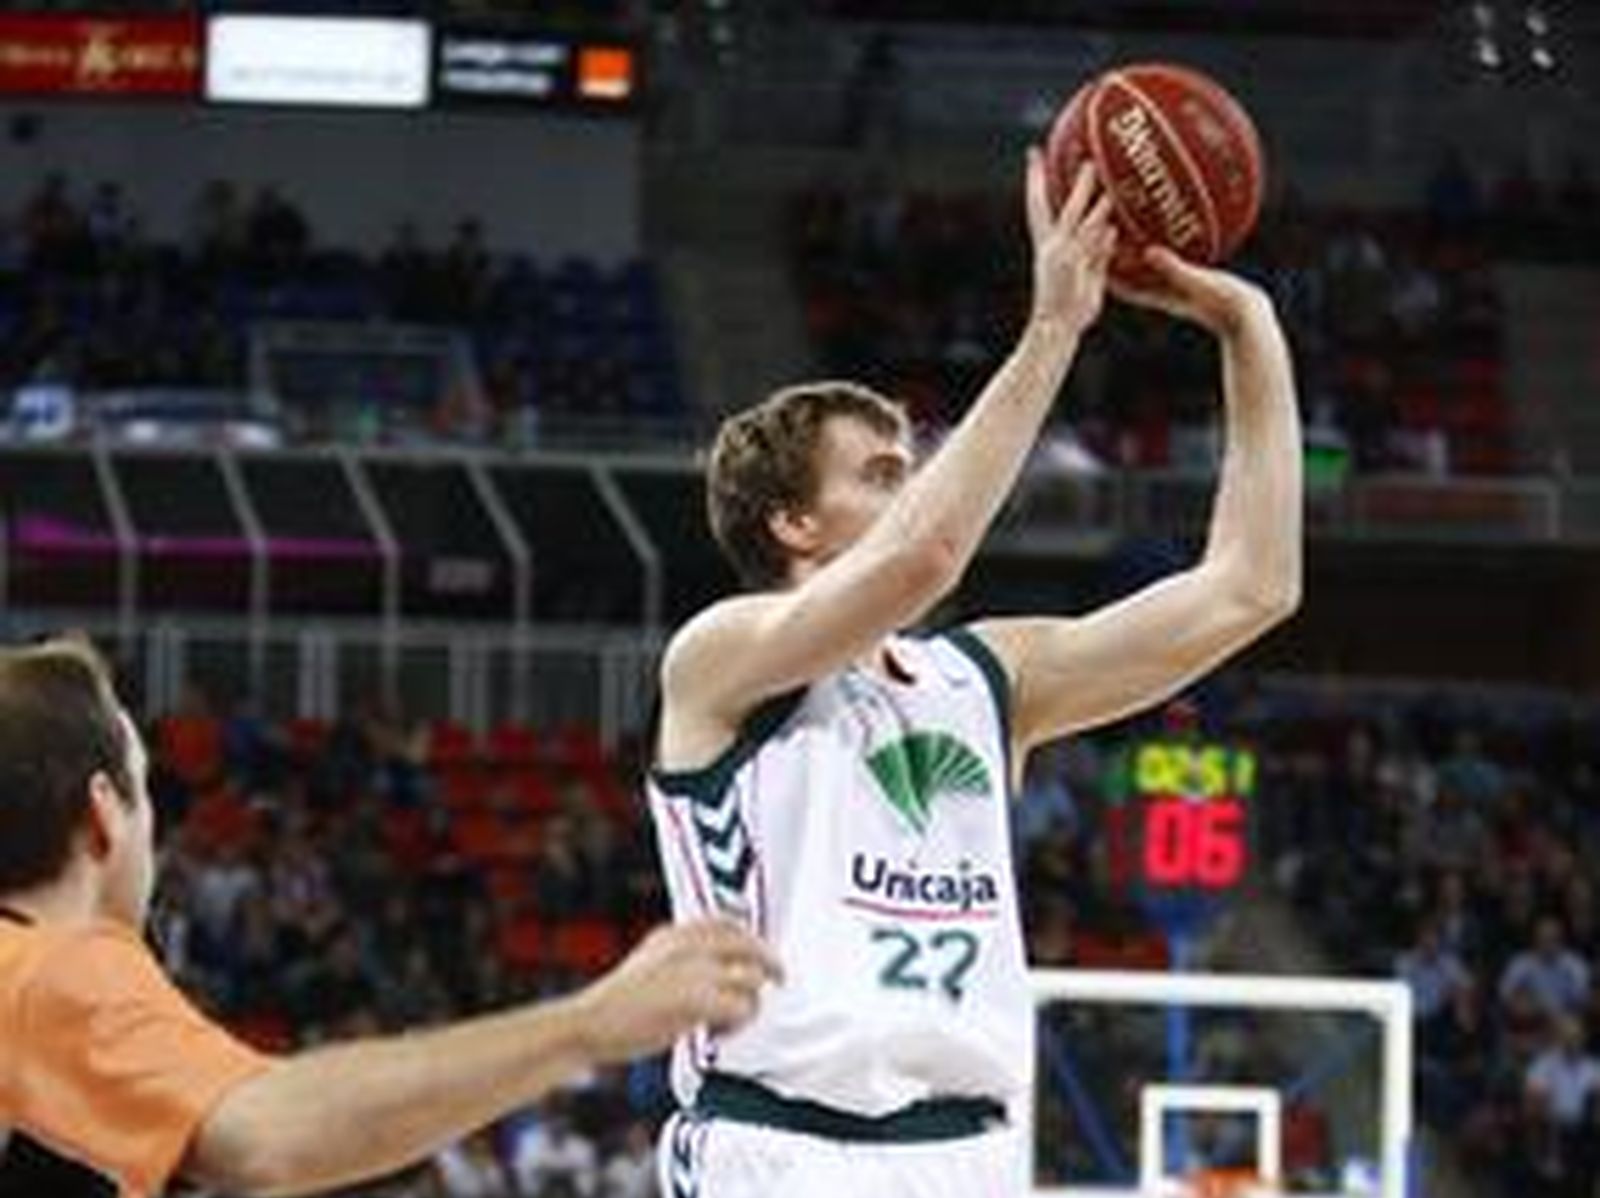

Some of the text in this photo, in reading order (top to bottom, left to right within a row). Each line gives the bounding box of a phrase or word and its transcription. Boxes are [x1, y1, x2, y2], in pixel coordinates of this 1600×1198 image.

[1145, 798, 1246, 886] 06
[852, 853, 998, 912] Unicaja
[871, 930, 979, 1001] 22
